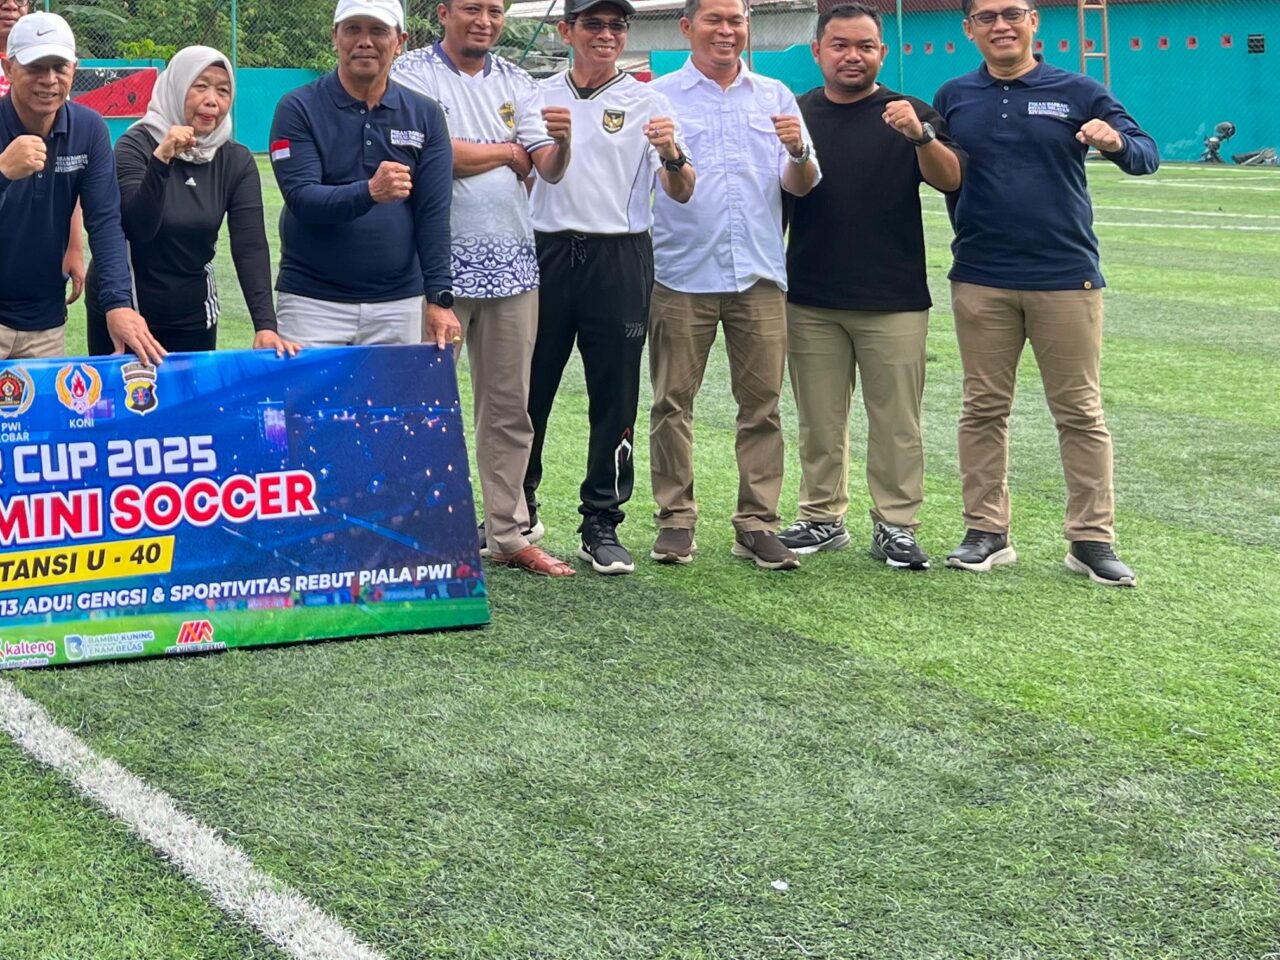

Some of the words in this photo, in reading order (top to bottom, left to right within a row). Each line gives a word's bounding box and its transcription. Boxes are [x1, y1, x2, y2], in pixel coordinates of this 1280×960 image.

[1, 422, 21, 432] PWI
[70, 419, 94, 428] KONI
[13, 441, 97, 483] CUP
[107, 435, 217, 478] 2025
[111, 471, 318, 532] SOCCER
[86, 548, 107, 572] U
[130, 542, 162, 567] 40
[22, 594, 73, 615] ADU!
[77, 588, 148, 610] GENGSI
[151, 586, 165, 603] &
[170, 576, 291, 602] SPORTIVITAS
[295, 571, 355, 591] REBUT
[359, 566, 412, 586] PIALA
[416, 563, 452, 581] PWI
[88, 635, 118, 644] BAMBU
[121, 632, 154, 641] KUNING
[5, 640, 55, 657] kalteng
[88, 646, 115, 656] ENAM
